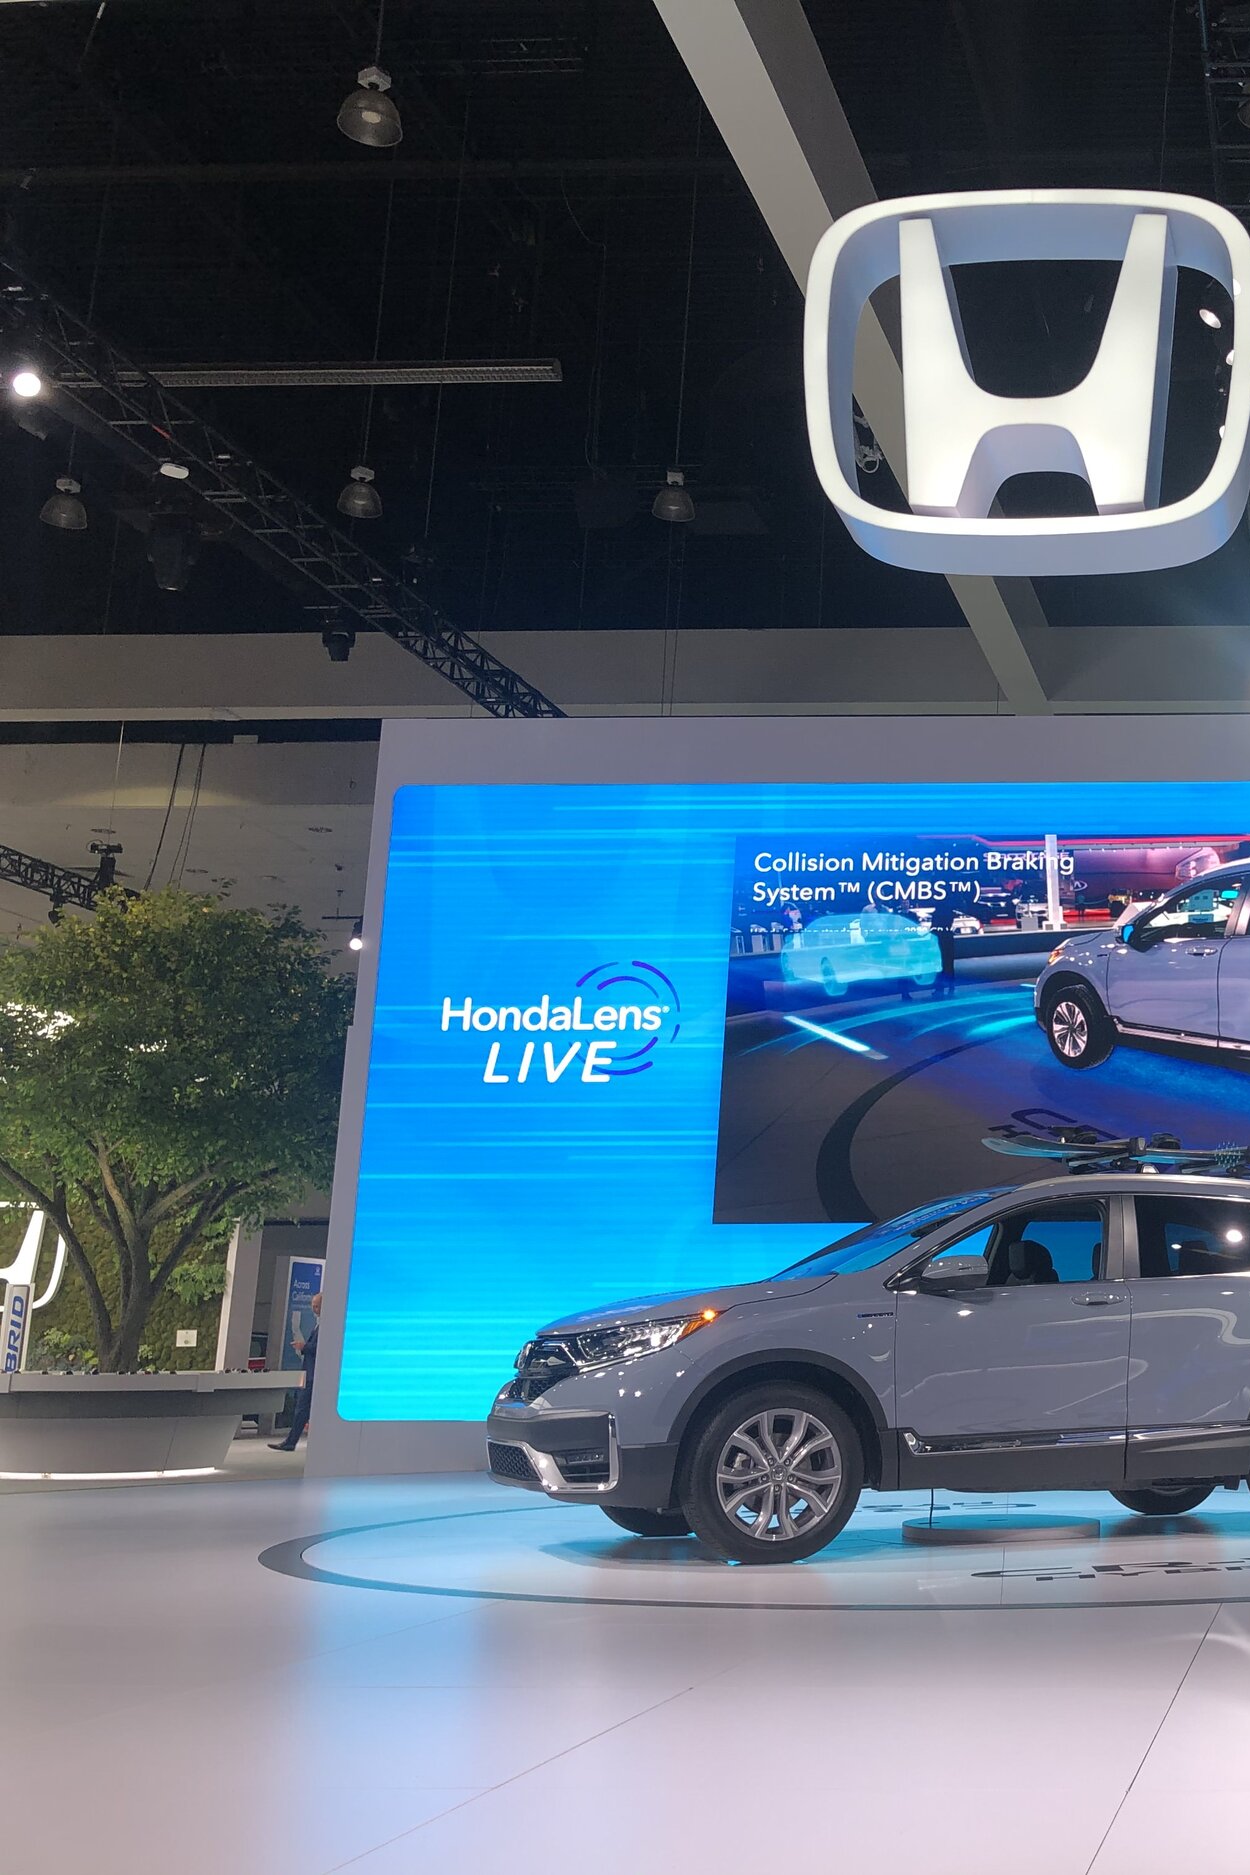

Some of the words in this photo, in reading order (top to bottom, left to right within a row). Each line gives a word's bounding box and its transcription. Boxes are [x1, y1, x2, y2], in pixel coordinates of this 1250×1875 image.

[754, 852, 854, 873] Collision
[862, 852, 979, 877] Mitigation
[987, 851, 1074, 877] Braking
[483, 1041, 617, 1083] LIVE
